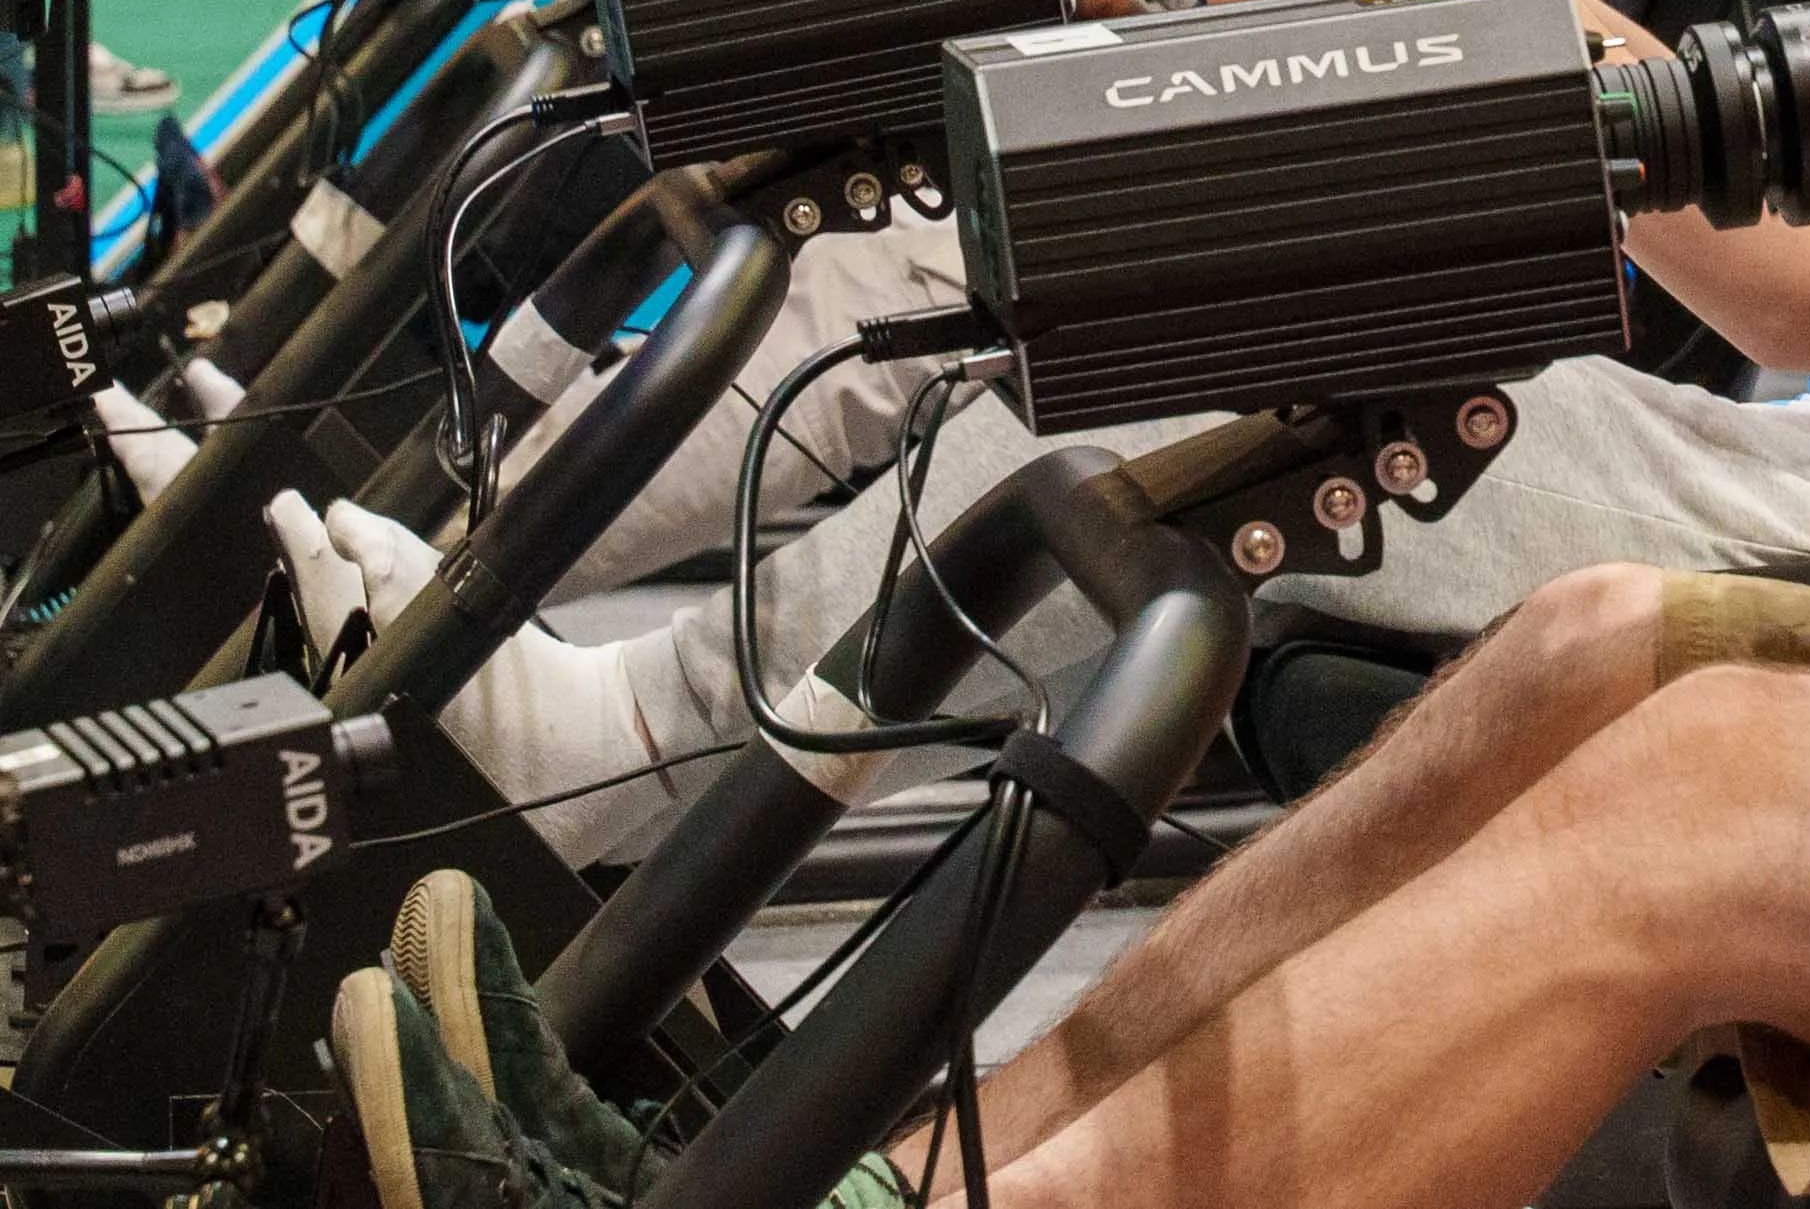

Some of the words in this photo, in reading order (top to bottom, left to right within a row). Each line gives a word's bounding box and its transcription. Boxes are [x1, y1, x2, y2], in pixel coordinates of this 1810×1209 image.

[1105, 33, 1465, 109] CAMMUS
[47, 302, 97, 389] AIDA
[279, 748, 334, 870] AIDA
